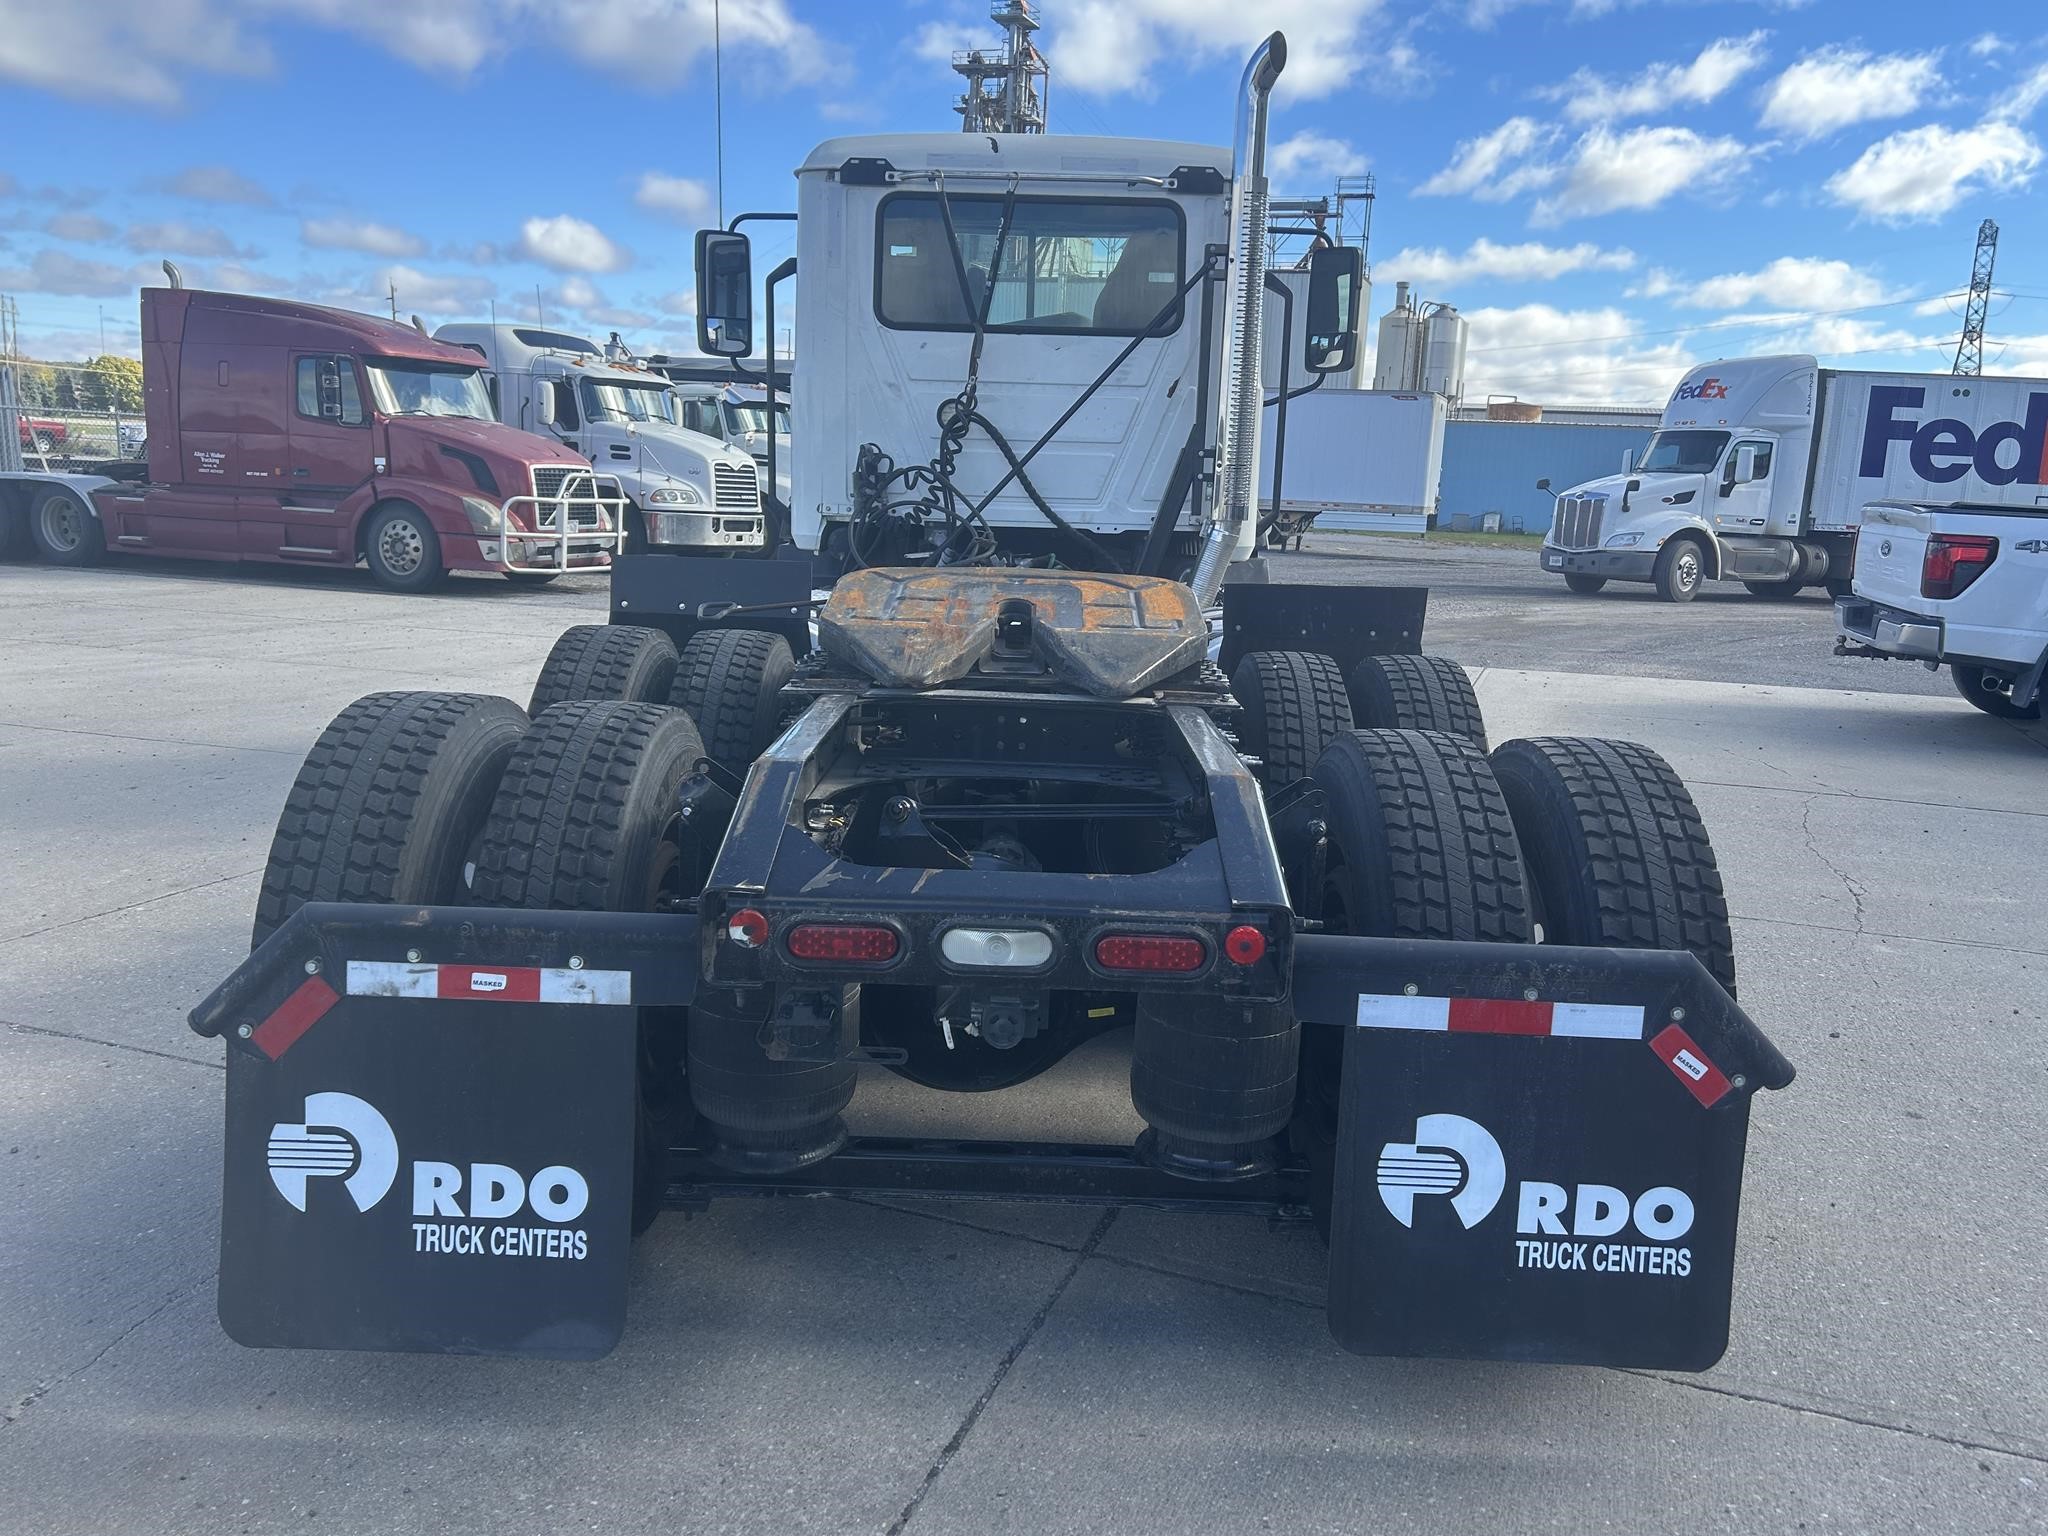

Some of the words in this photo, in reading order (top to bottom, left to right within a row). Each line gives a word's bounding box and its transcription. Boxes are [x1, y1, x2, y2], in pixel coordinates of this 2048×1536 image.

[1673, 378, 1728, 401] FedEx
[1858, 385, 2048, 486] Fed
[472, 980, 503, 988] MASKED
[1676, 1055, 1701, 1076] MASKED
[413, 1161, 589, 1222] RDO
[1516, 1181, 1695, 1240] RDO
[413, 1224, 486, 1255] TRUCK
[491, 1227, 588, 1260] CENTERS
[1516, 1241, 1588, 1271] TRUCK
[1593, 1244, 1692, 1277] CENTERS
